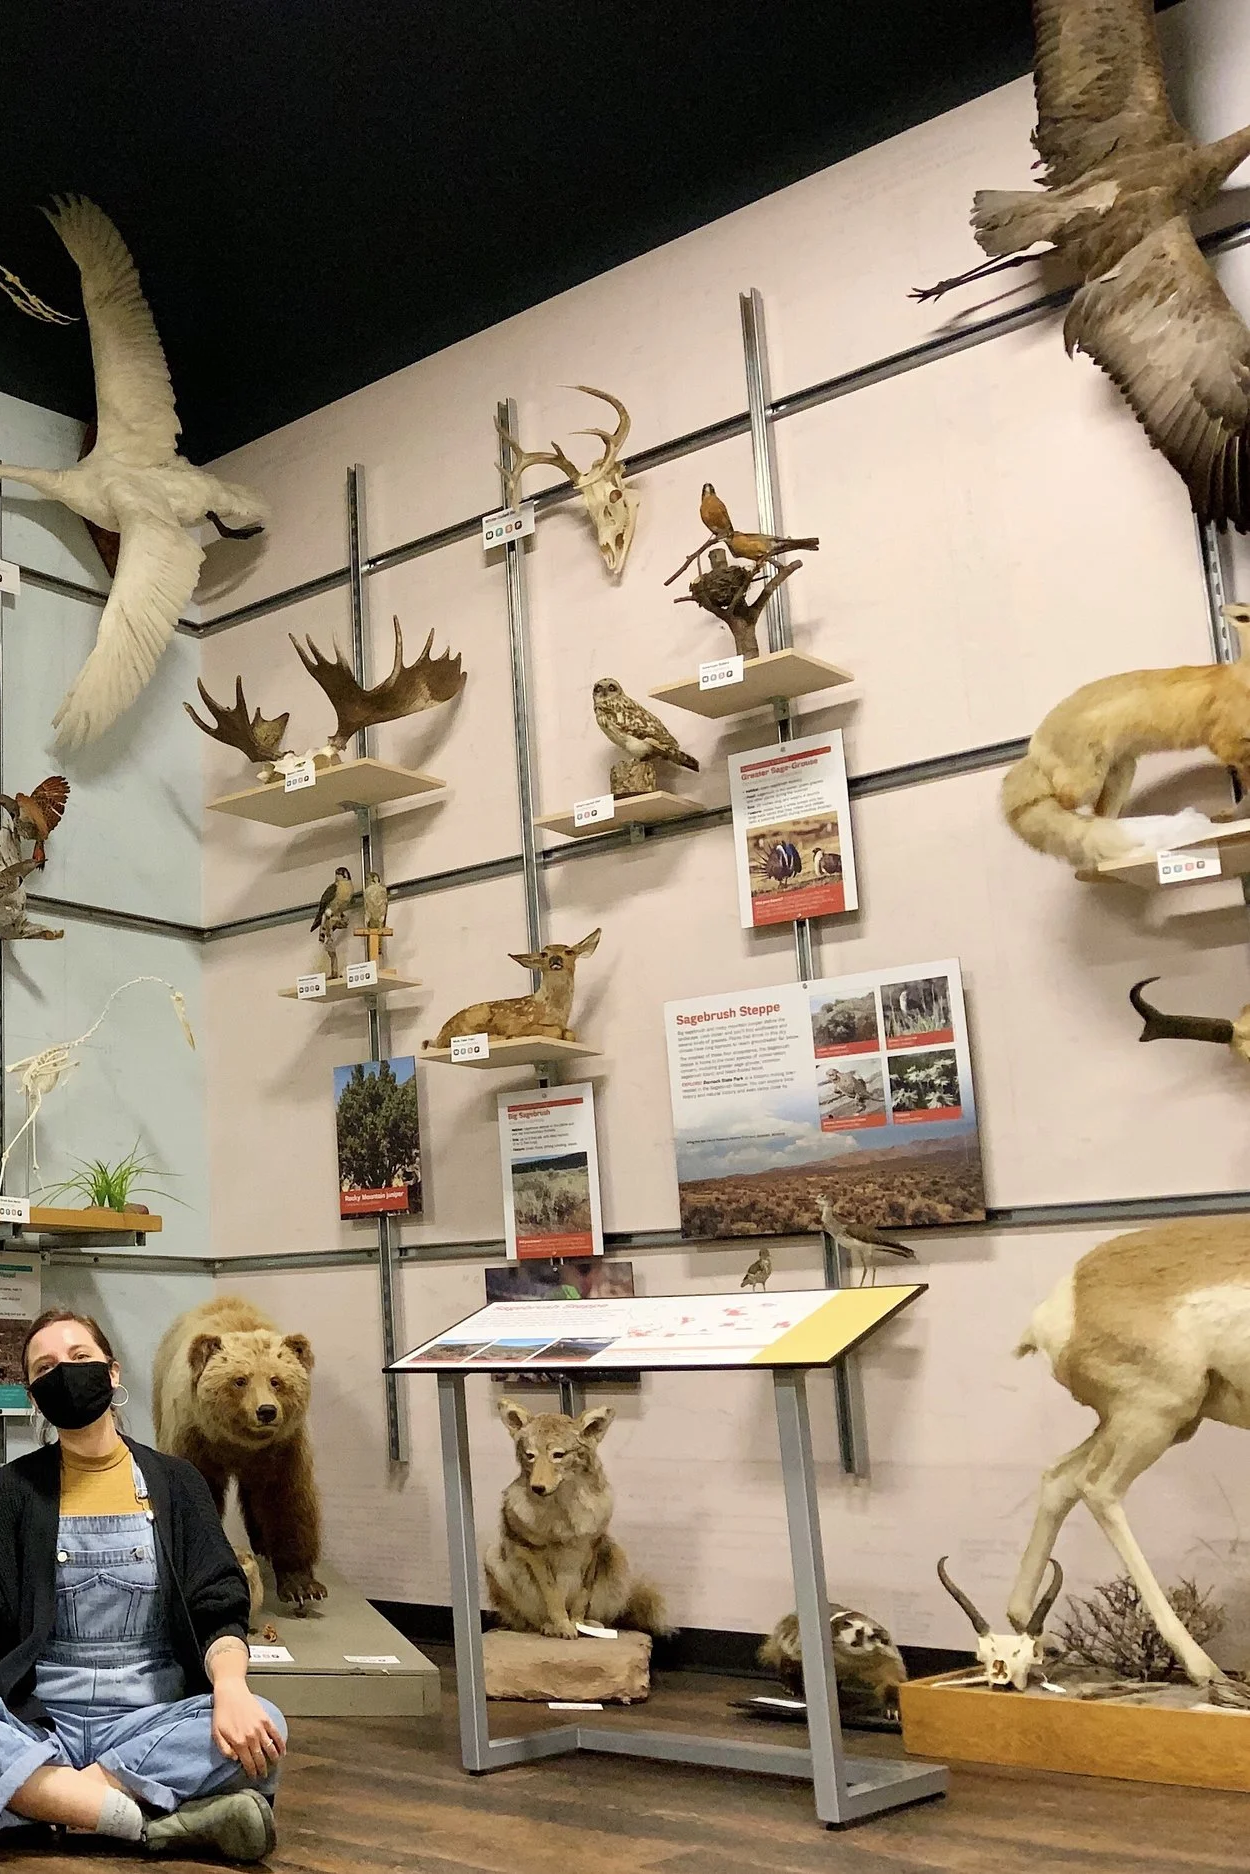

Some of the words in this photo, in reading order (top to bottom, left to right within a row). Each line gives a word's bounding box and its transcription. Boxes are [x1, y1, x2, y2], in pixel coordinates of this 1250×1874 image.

[741, 770, 769, 780] Greater
[770, 758, 818, 774] Sage-Grouse
[676, 1008, 736, 1026] Sagebrush
[740, 1003, 780, 1016] Steppe
